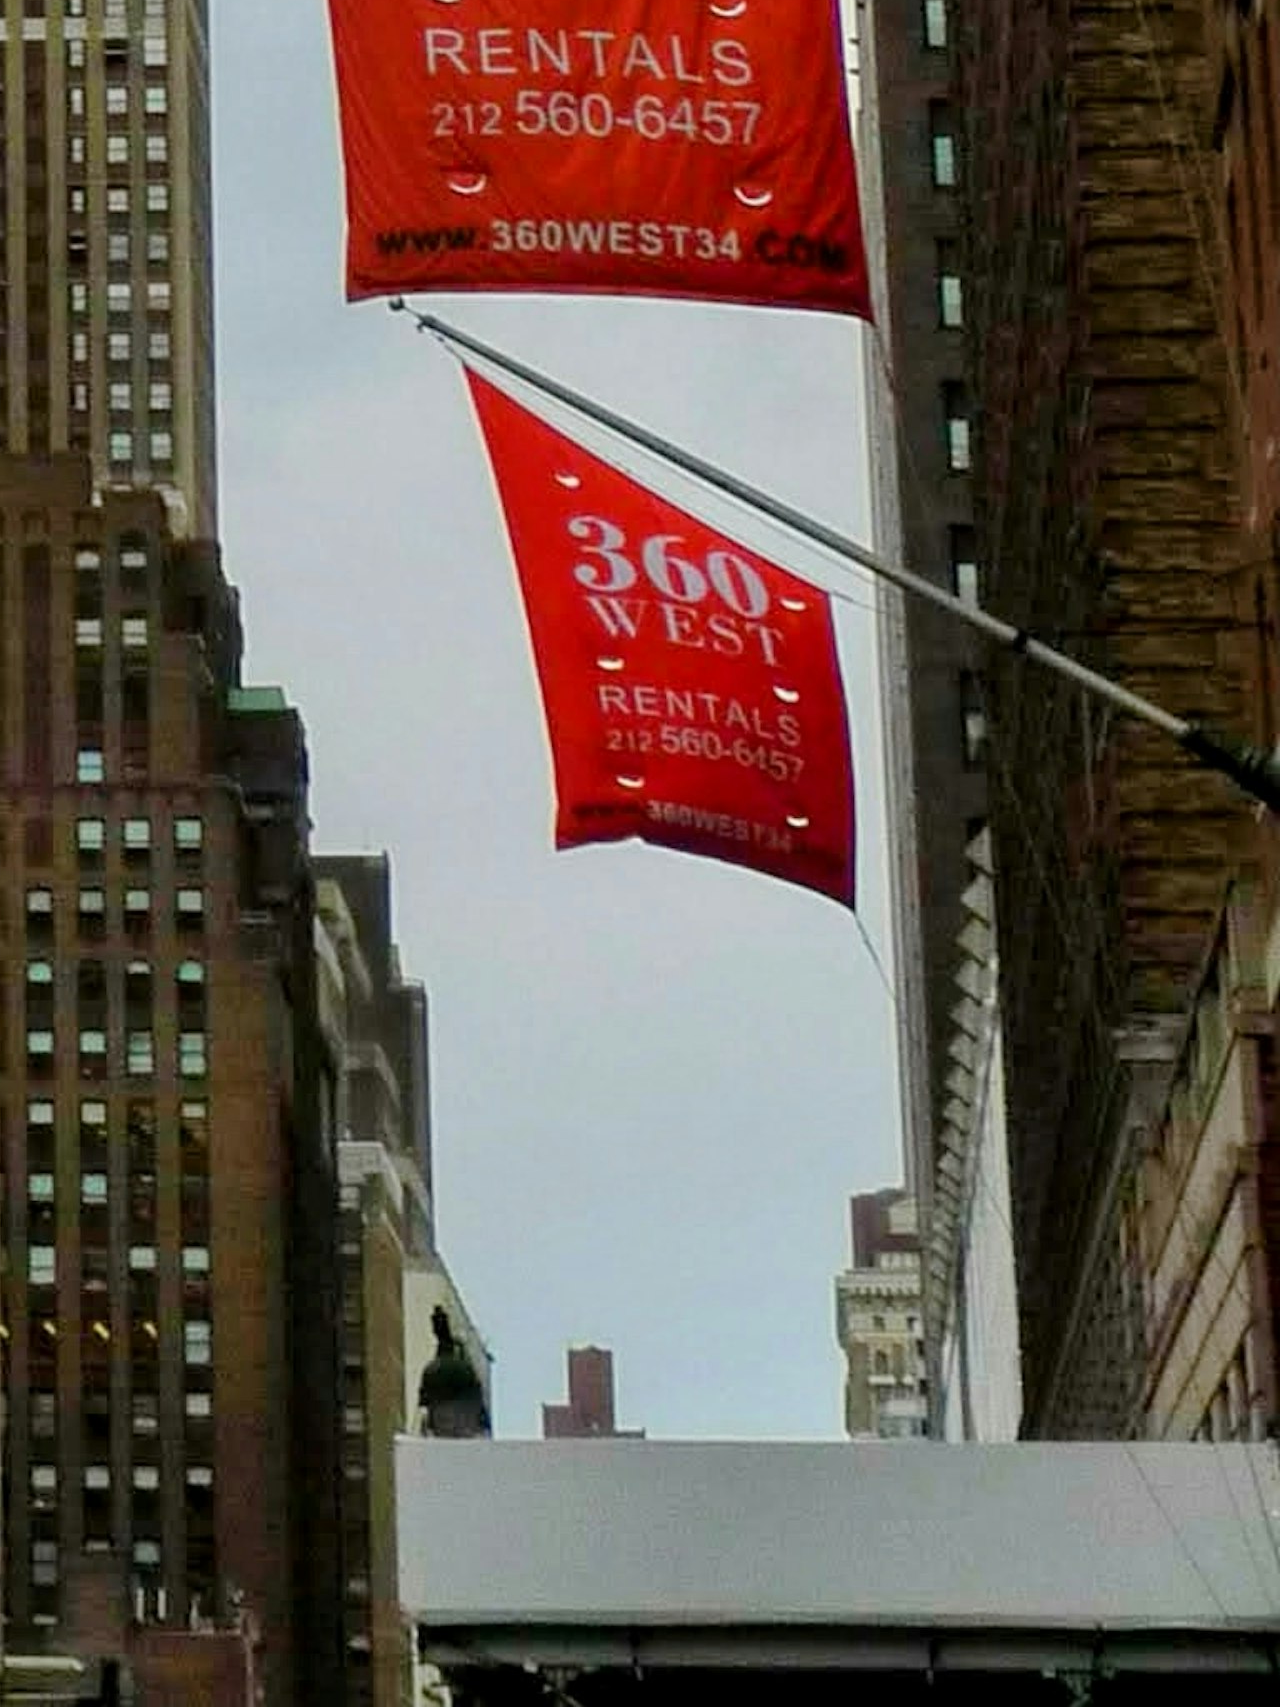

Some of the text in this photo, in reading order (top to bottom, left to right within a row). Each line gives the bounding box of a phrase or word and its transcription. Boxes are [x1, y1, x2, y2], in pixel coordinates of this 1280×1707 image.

[424, 28, 753, 86] RENTALS
[433, 91, 761, 147] 212 560-6457
[567, 515, 771, 621] 360
[585, 596, 784, 668] WEST
[598, 684, 802, 748] RENTALS
[606, 724, 806, 784] 212 560-6457
